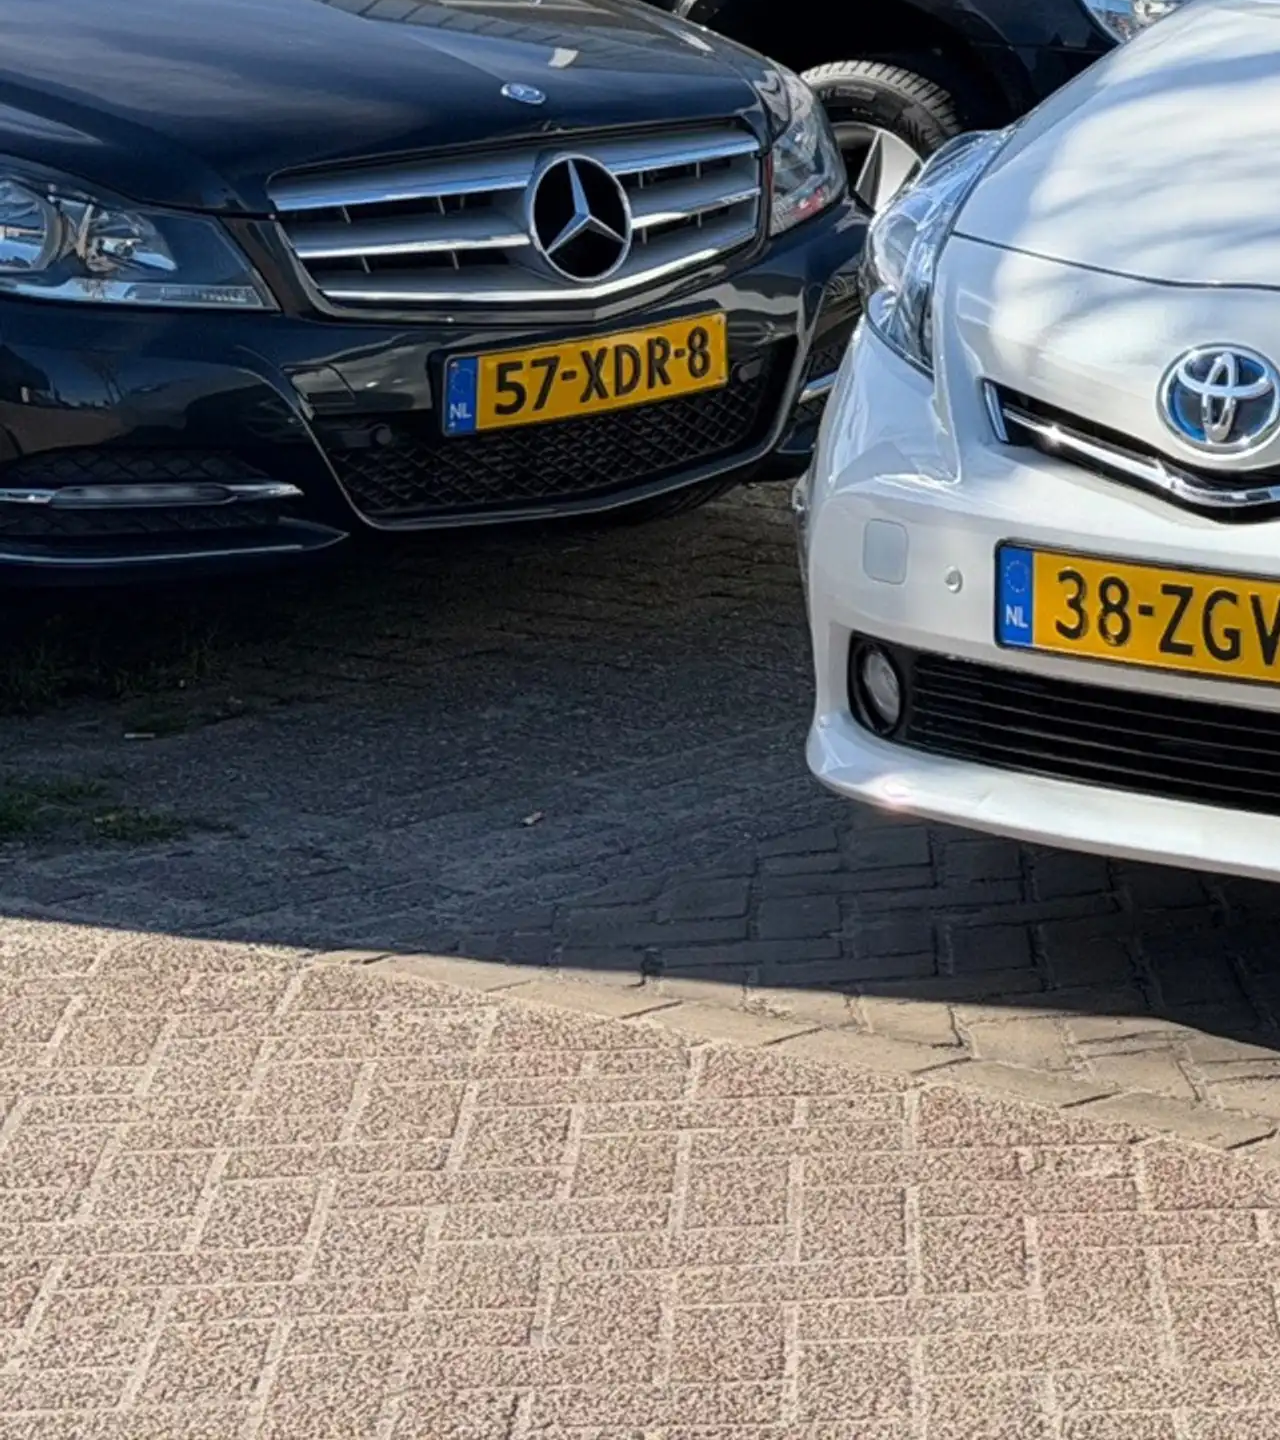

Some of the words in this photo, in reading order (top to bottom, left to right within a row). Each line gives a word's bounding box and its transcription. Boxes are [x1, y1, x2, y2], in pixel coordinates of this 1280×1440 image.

[449, 402, 473, 420] NL
[494, 325, 710, 416] 57-XDR-8
[1004, 604, 1029, 630] NL
